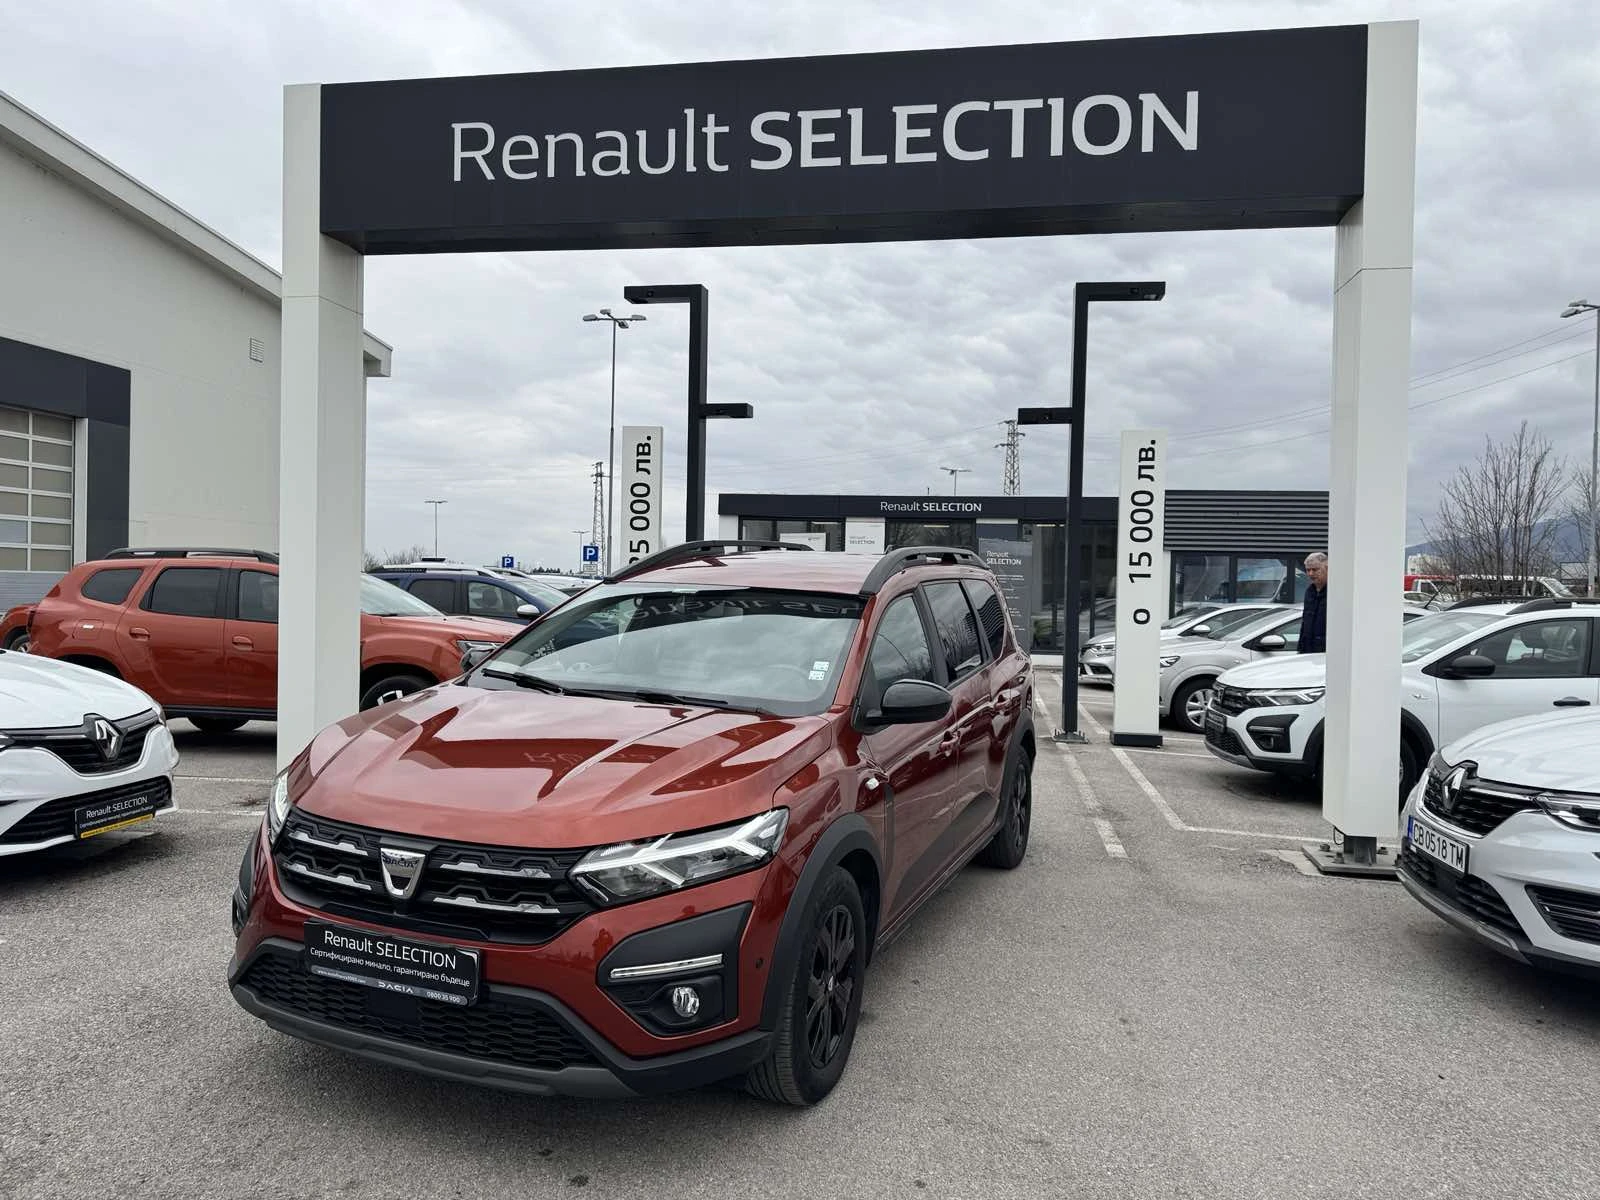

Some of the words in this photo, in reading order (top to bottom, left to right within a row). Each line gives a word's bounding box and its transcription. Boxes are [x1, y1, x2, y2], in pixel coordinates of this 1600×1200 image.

[451, 108, 730, 183] Renault
[750, 90, 1200, 172] SELECTION
[636, 436, 651, 475] лв.
[1137, 439, 1156, 482] лв.
[630, 483, 651, 531] 000
[880, 502, 921, 511] Renault
[922, 502, 982, 512] SELECTION
[1130, 490, 1154, 542] 000
[504, 558, 511, 567] P
[586, 548, 595, 560] P
[986, 558, 1022, 566] SELECTION
[1128, 552, 1152, 584] 15
[86, 804, 112, 819] Renault
[112, 796, 148, 812] SELECTION
[310, 947, 364, 966] Сертифицирано
[394, 966, 439, 981] гарантирано
[440, 972, 470, 987] бъдеще
[324, 930, 373, 954] Renault
[376, 942, 456, 970] SELECTION
[378, 982, 414, 994] DACIA
